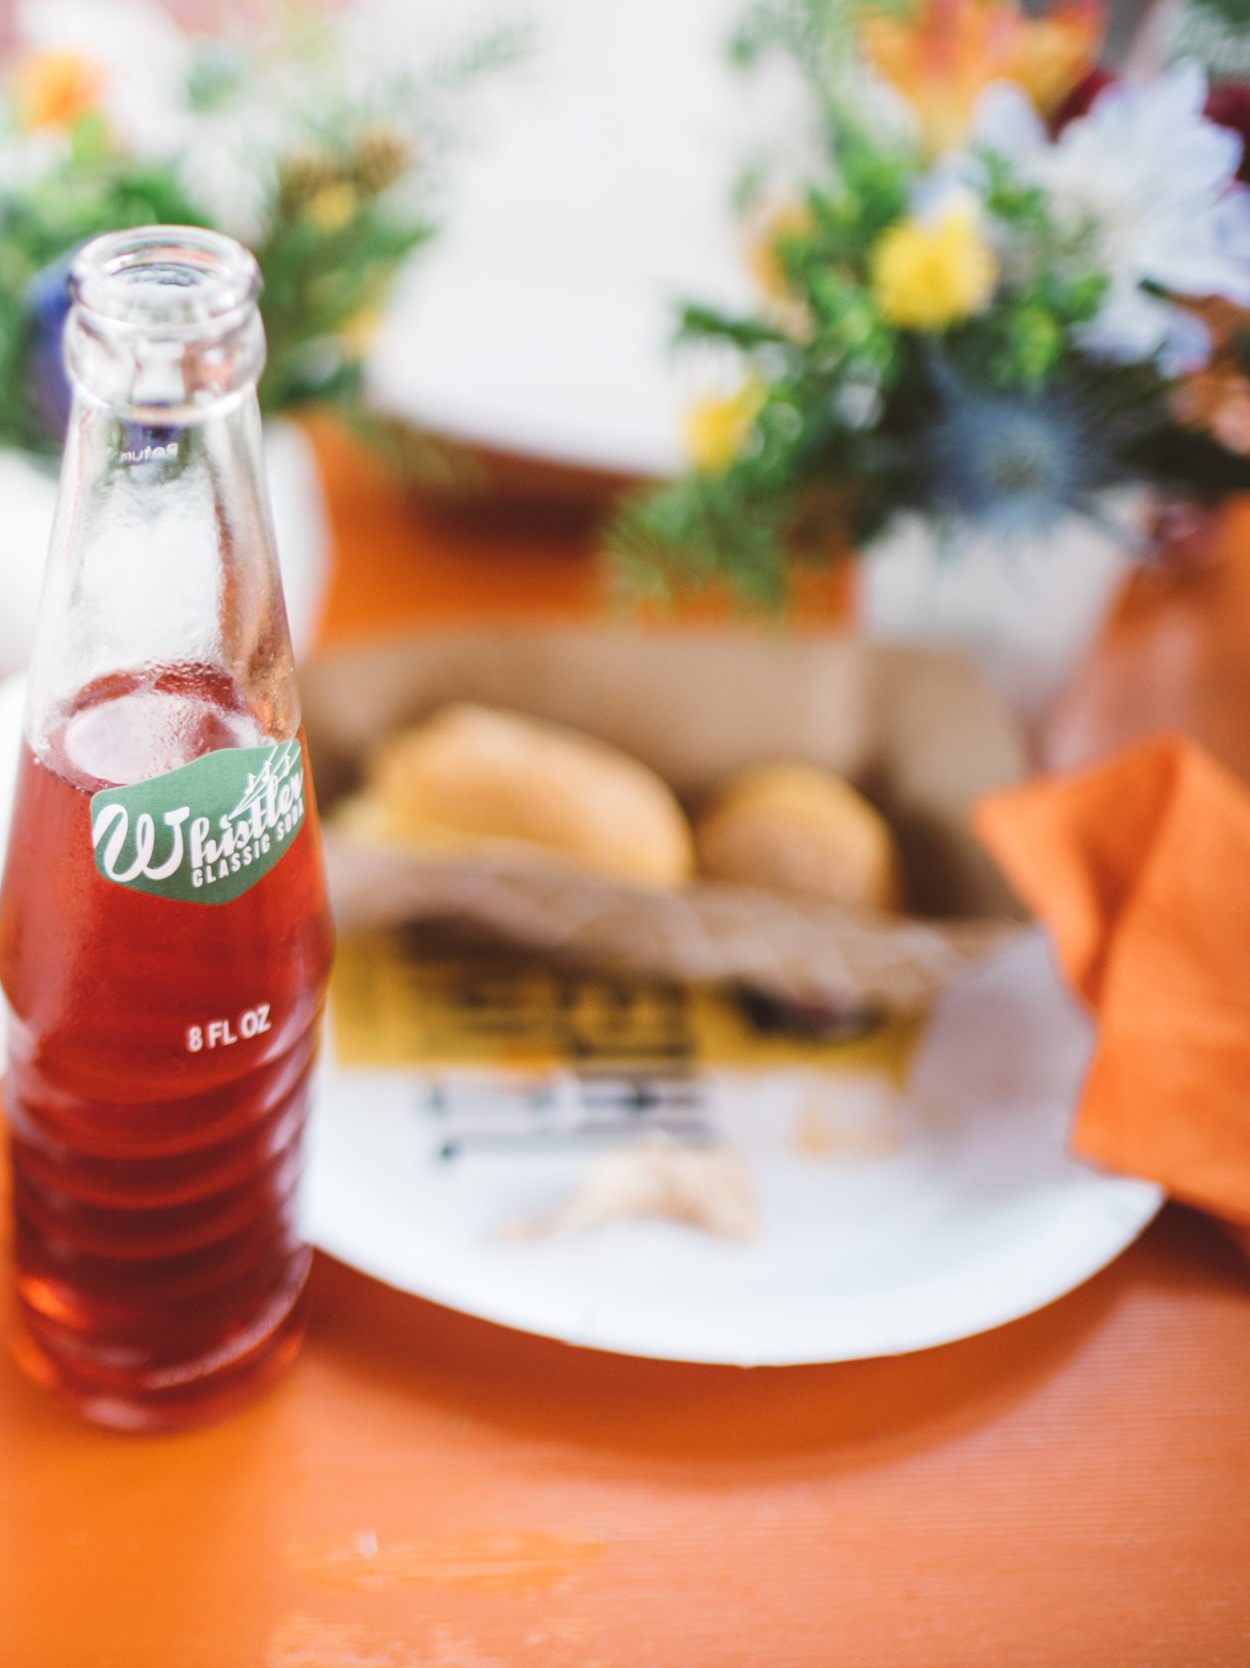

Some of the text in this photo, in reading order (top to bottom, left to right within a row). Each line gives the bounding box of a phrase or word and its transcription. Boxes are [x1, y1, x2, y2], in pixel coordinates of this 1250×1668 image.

[92, 768, 304, 882] Whistler
[192, 834, 271, 888] CLASSIC
[187, 1003, 272, 1053] 8 FL OZ
